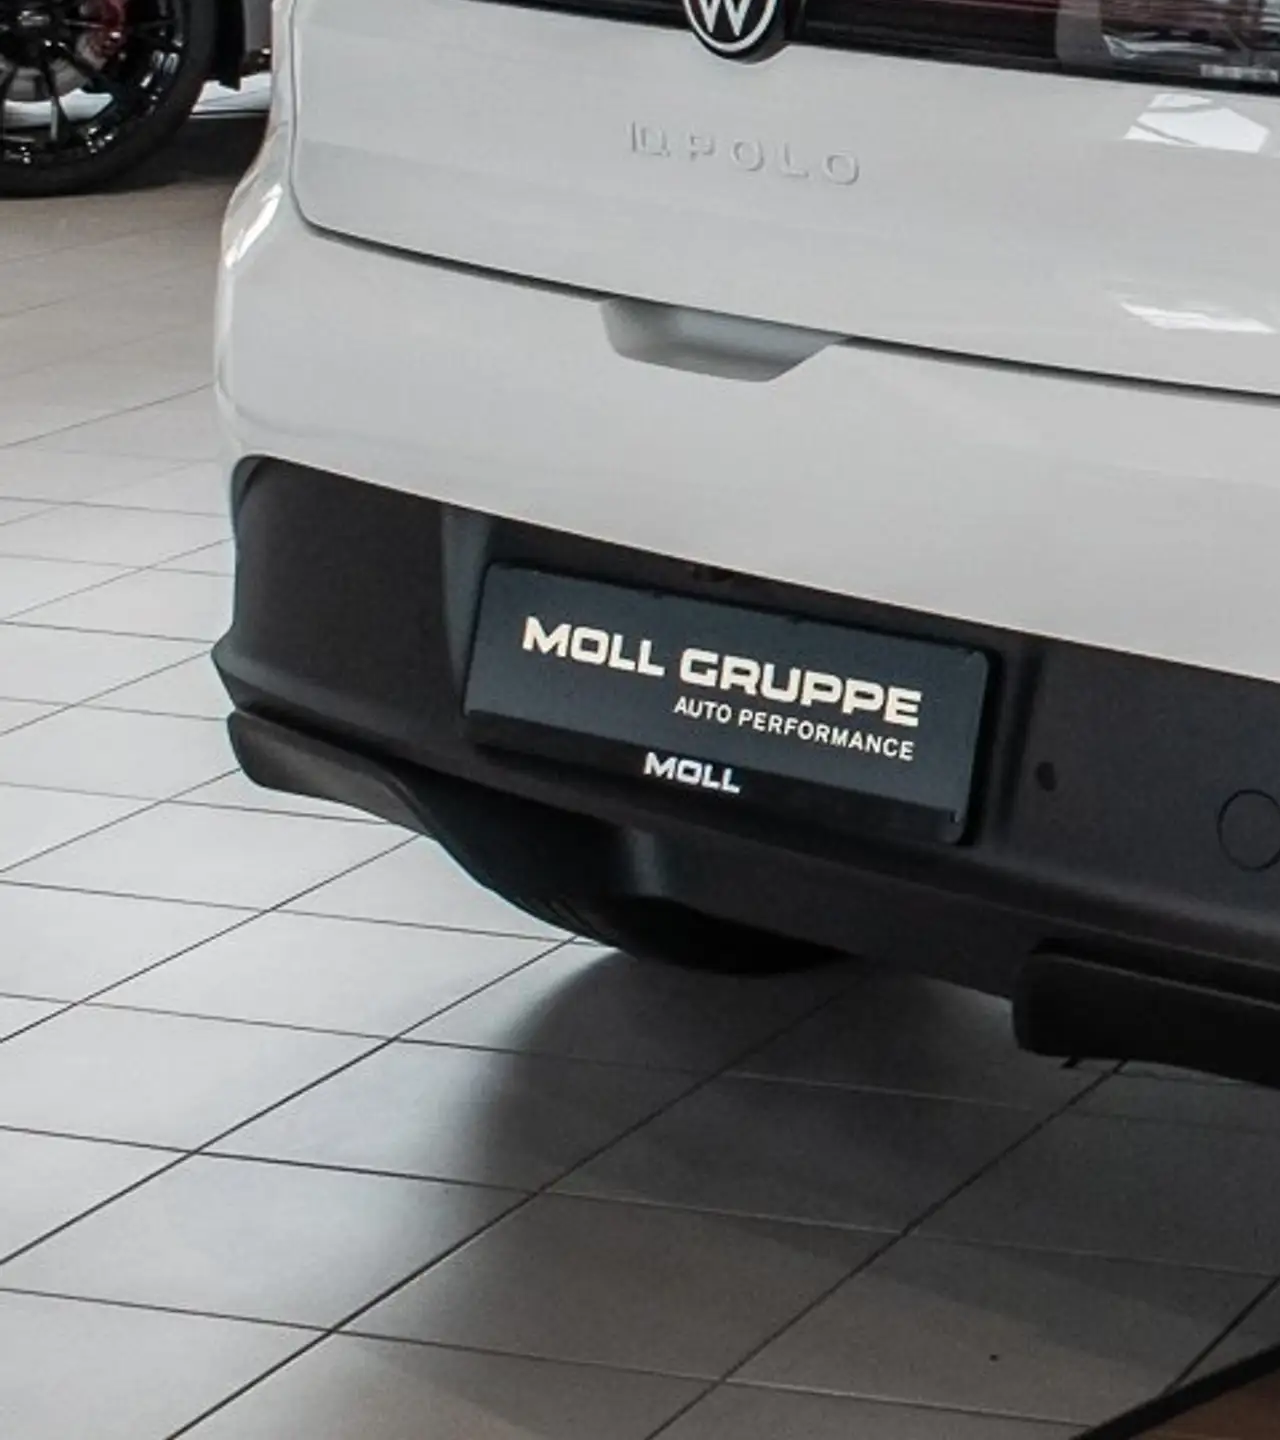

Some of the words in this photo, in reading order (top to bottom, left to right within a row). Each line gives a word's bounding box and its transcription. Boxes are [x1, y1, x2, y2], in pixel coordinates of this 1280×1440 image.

[686, 133, 860, 186] POLO
[521, 617, 665, 677] MOLL
[679, 647, 923, 727] GRUPPE
[674, 696, 732, 724] AUTO
[738, 709, 914, 761] PERFORMANCE
[644, 752, 741, 794] MOLL
